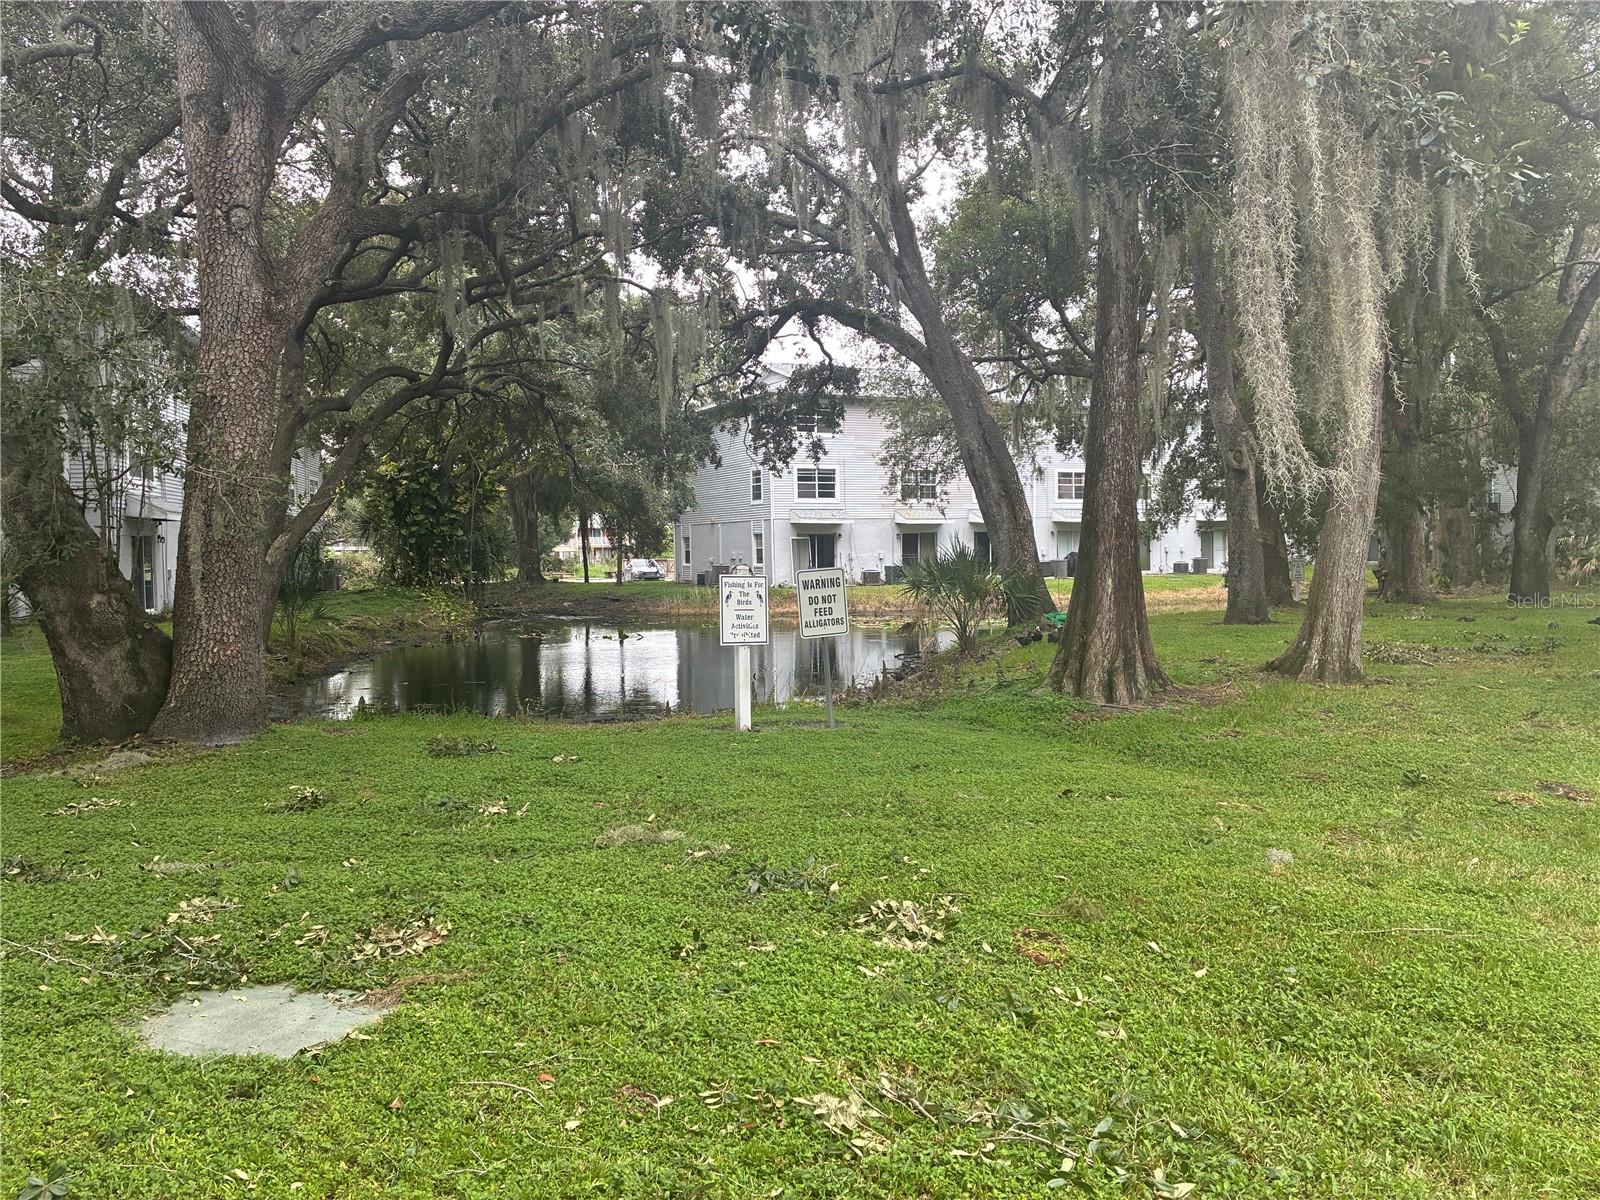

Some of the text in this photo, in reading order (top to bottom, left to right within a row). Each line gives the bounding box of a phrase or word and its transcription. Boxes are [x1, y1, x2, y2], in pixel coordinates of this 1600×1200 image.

[724, 581, 746, 589] Fishing
[801, 577, 841, 590] WARNING
[736, 598, 752, 606] Birds
[808, 594, 837, 606] DO NOT
[735, 613, 754, 621] Water
[814, 606, 833, 617] FEED
[804, 617, 845, 629] ALLIGATORS
